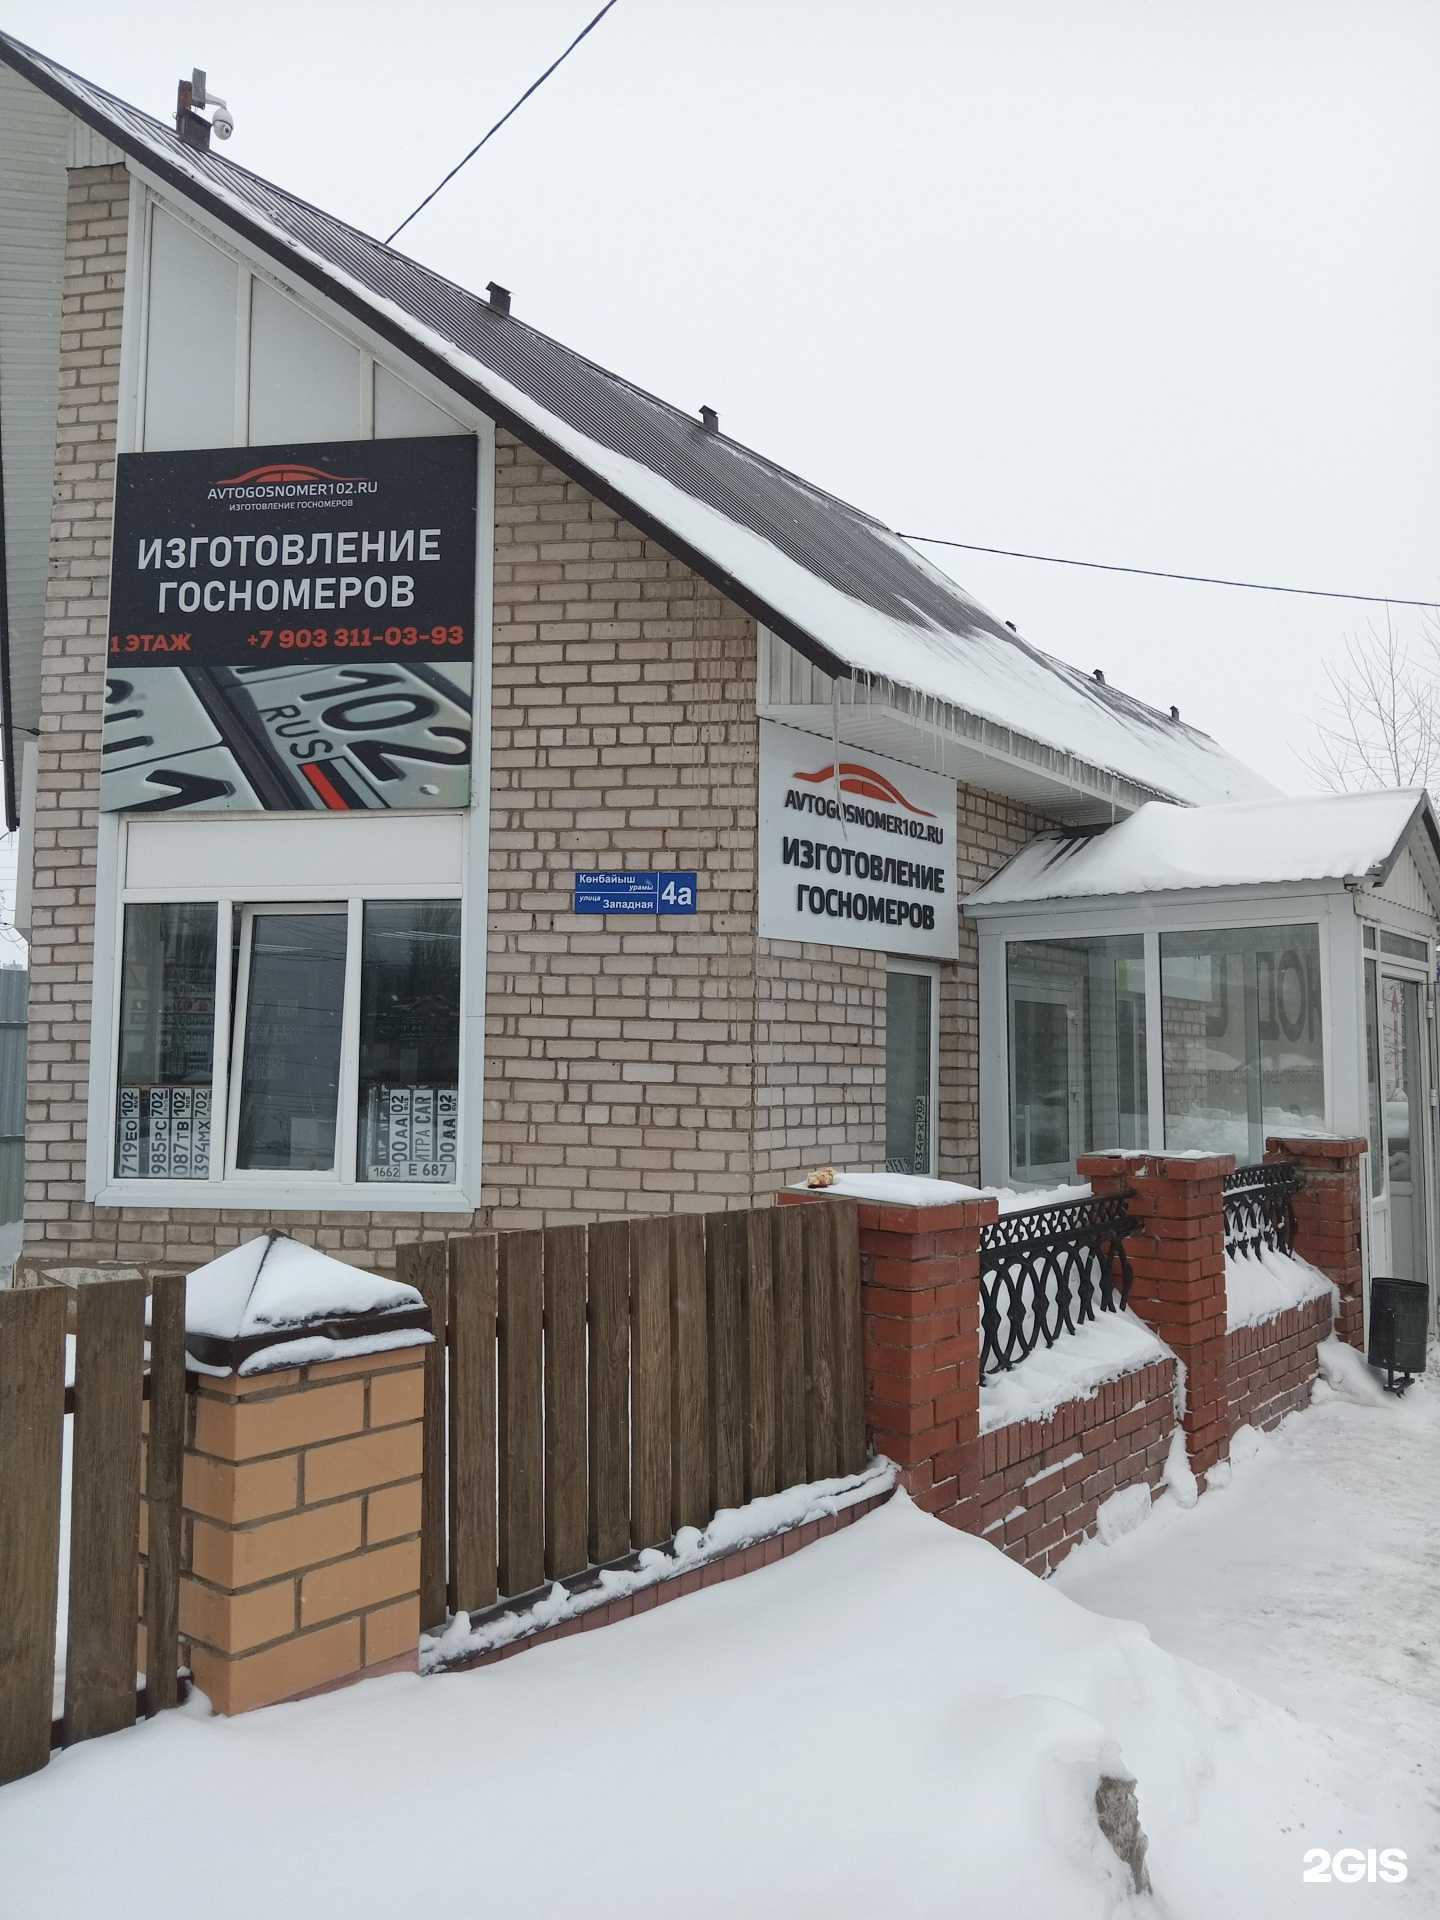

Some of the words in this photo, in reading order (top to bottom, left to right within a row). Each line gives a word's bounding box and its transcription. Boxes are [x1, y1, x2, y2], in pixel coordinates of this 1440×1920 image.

[207, 481, 378, 500] AVTOGOSNOMER102.RU
[229, 501, 296, 512] ИЗГОТОВЛЕНИЕ
[297, 499, 354, 510] ГОСНОМЕРОВ
[137, 528, 442, 570] ИЗГОТОВЛЕНИЕ
[158, 575, 416, 613] ГОСНОМЕРОВ
[125, 632, 193, 653] ЭТАЖ
[247, 633, 273, 650] +7
[279, 630, 327, 649] 903
[334, 626, 464, 648] 311-03-93
[258, 703, 334, 761] RUS
[783, 788, 944, 845] AVTOGOSNOMER102.RU
[782, 836, 945, 893] ИЗГОТОВЛЕНИЕ
[579, 873, 636, 885] Көнбайыш
[578, 895, 602, 903] улица
[602, 899, 654, 910] Западная
[661, 880, 693, 905] 4а
[797, 884, 935, 931] ГОСНОМЕРОВ
[121, 1092, 134, 1117] 102
[151, 1092, 164, 1117] 702
[173, 1092, 186, 1117] 102
[195, 1092, 208, 1117] 702
[391, 1095, 404, 1113] 02
[415, 1096, 431, 1124] CAR
[440, 1094, 452, 1112] 02
[422, 1163, 447, 1176] 687
